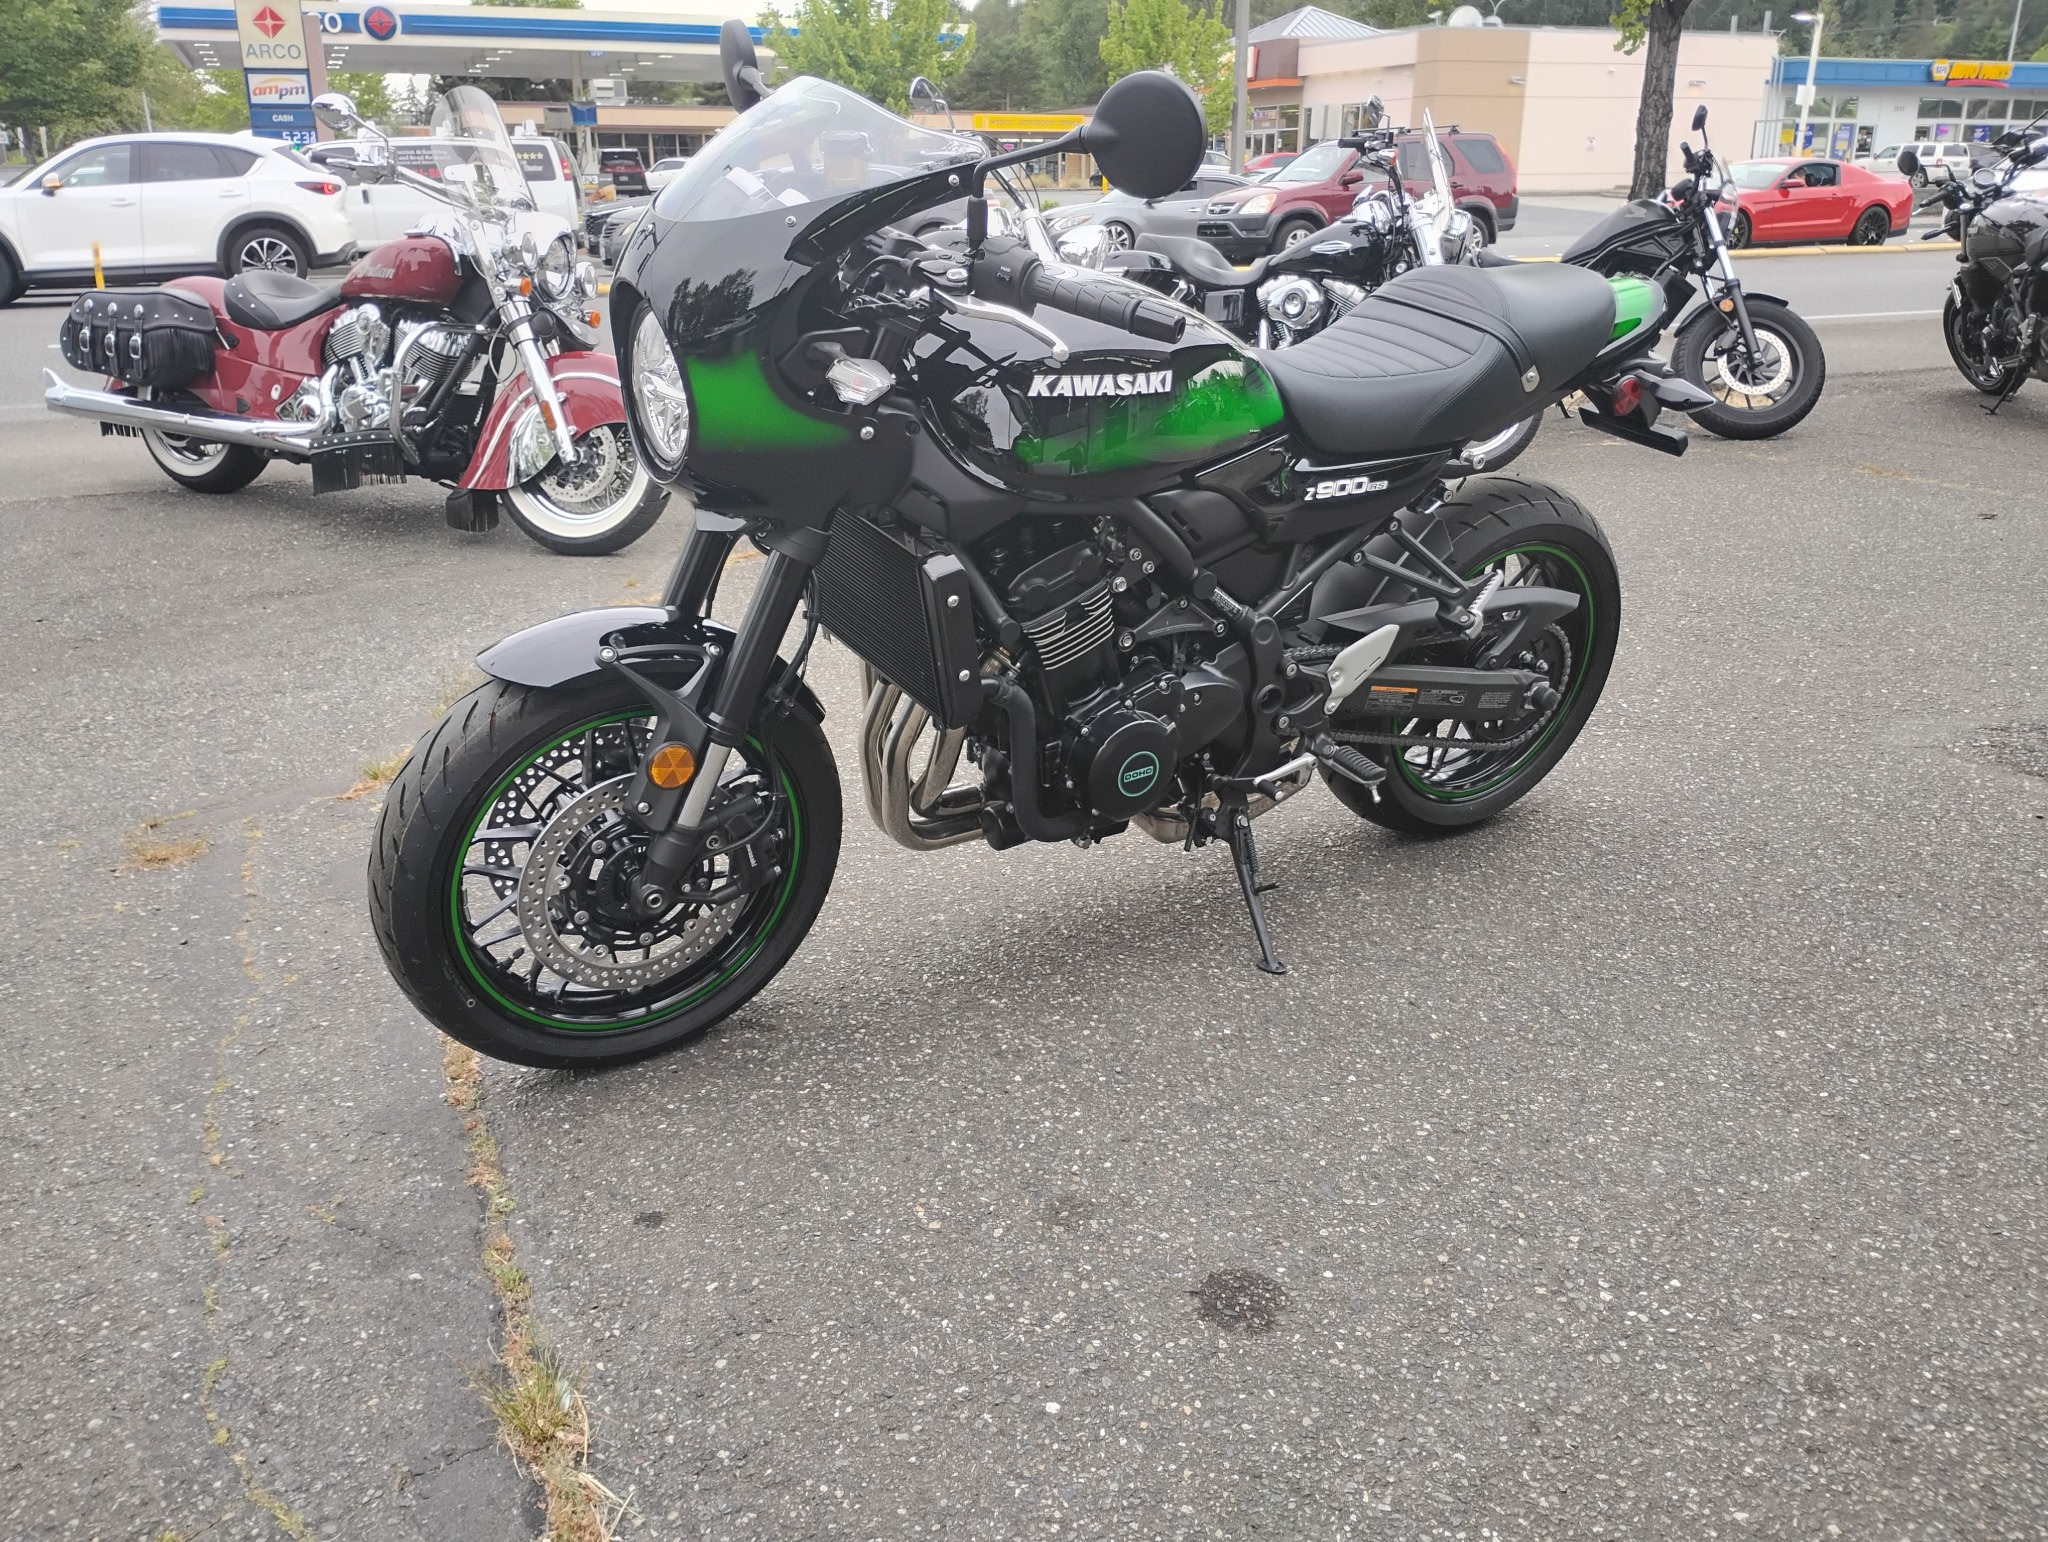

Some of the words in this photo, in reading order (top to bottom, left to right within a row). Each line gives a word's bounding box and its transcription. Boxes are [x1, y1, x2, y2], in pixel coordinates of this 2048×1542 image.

[246, 43, 302, 60] ARCO
[252, 86, 306, 100] ampm
[272, 114, 294, 122] CASH
[1027, 370, 1173, 397] KAWASAKI
[1124, 766, 1154, 782] DOHC
